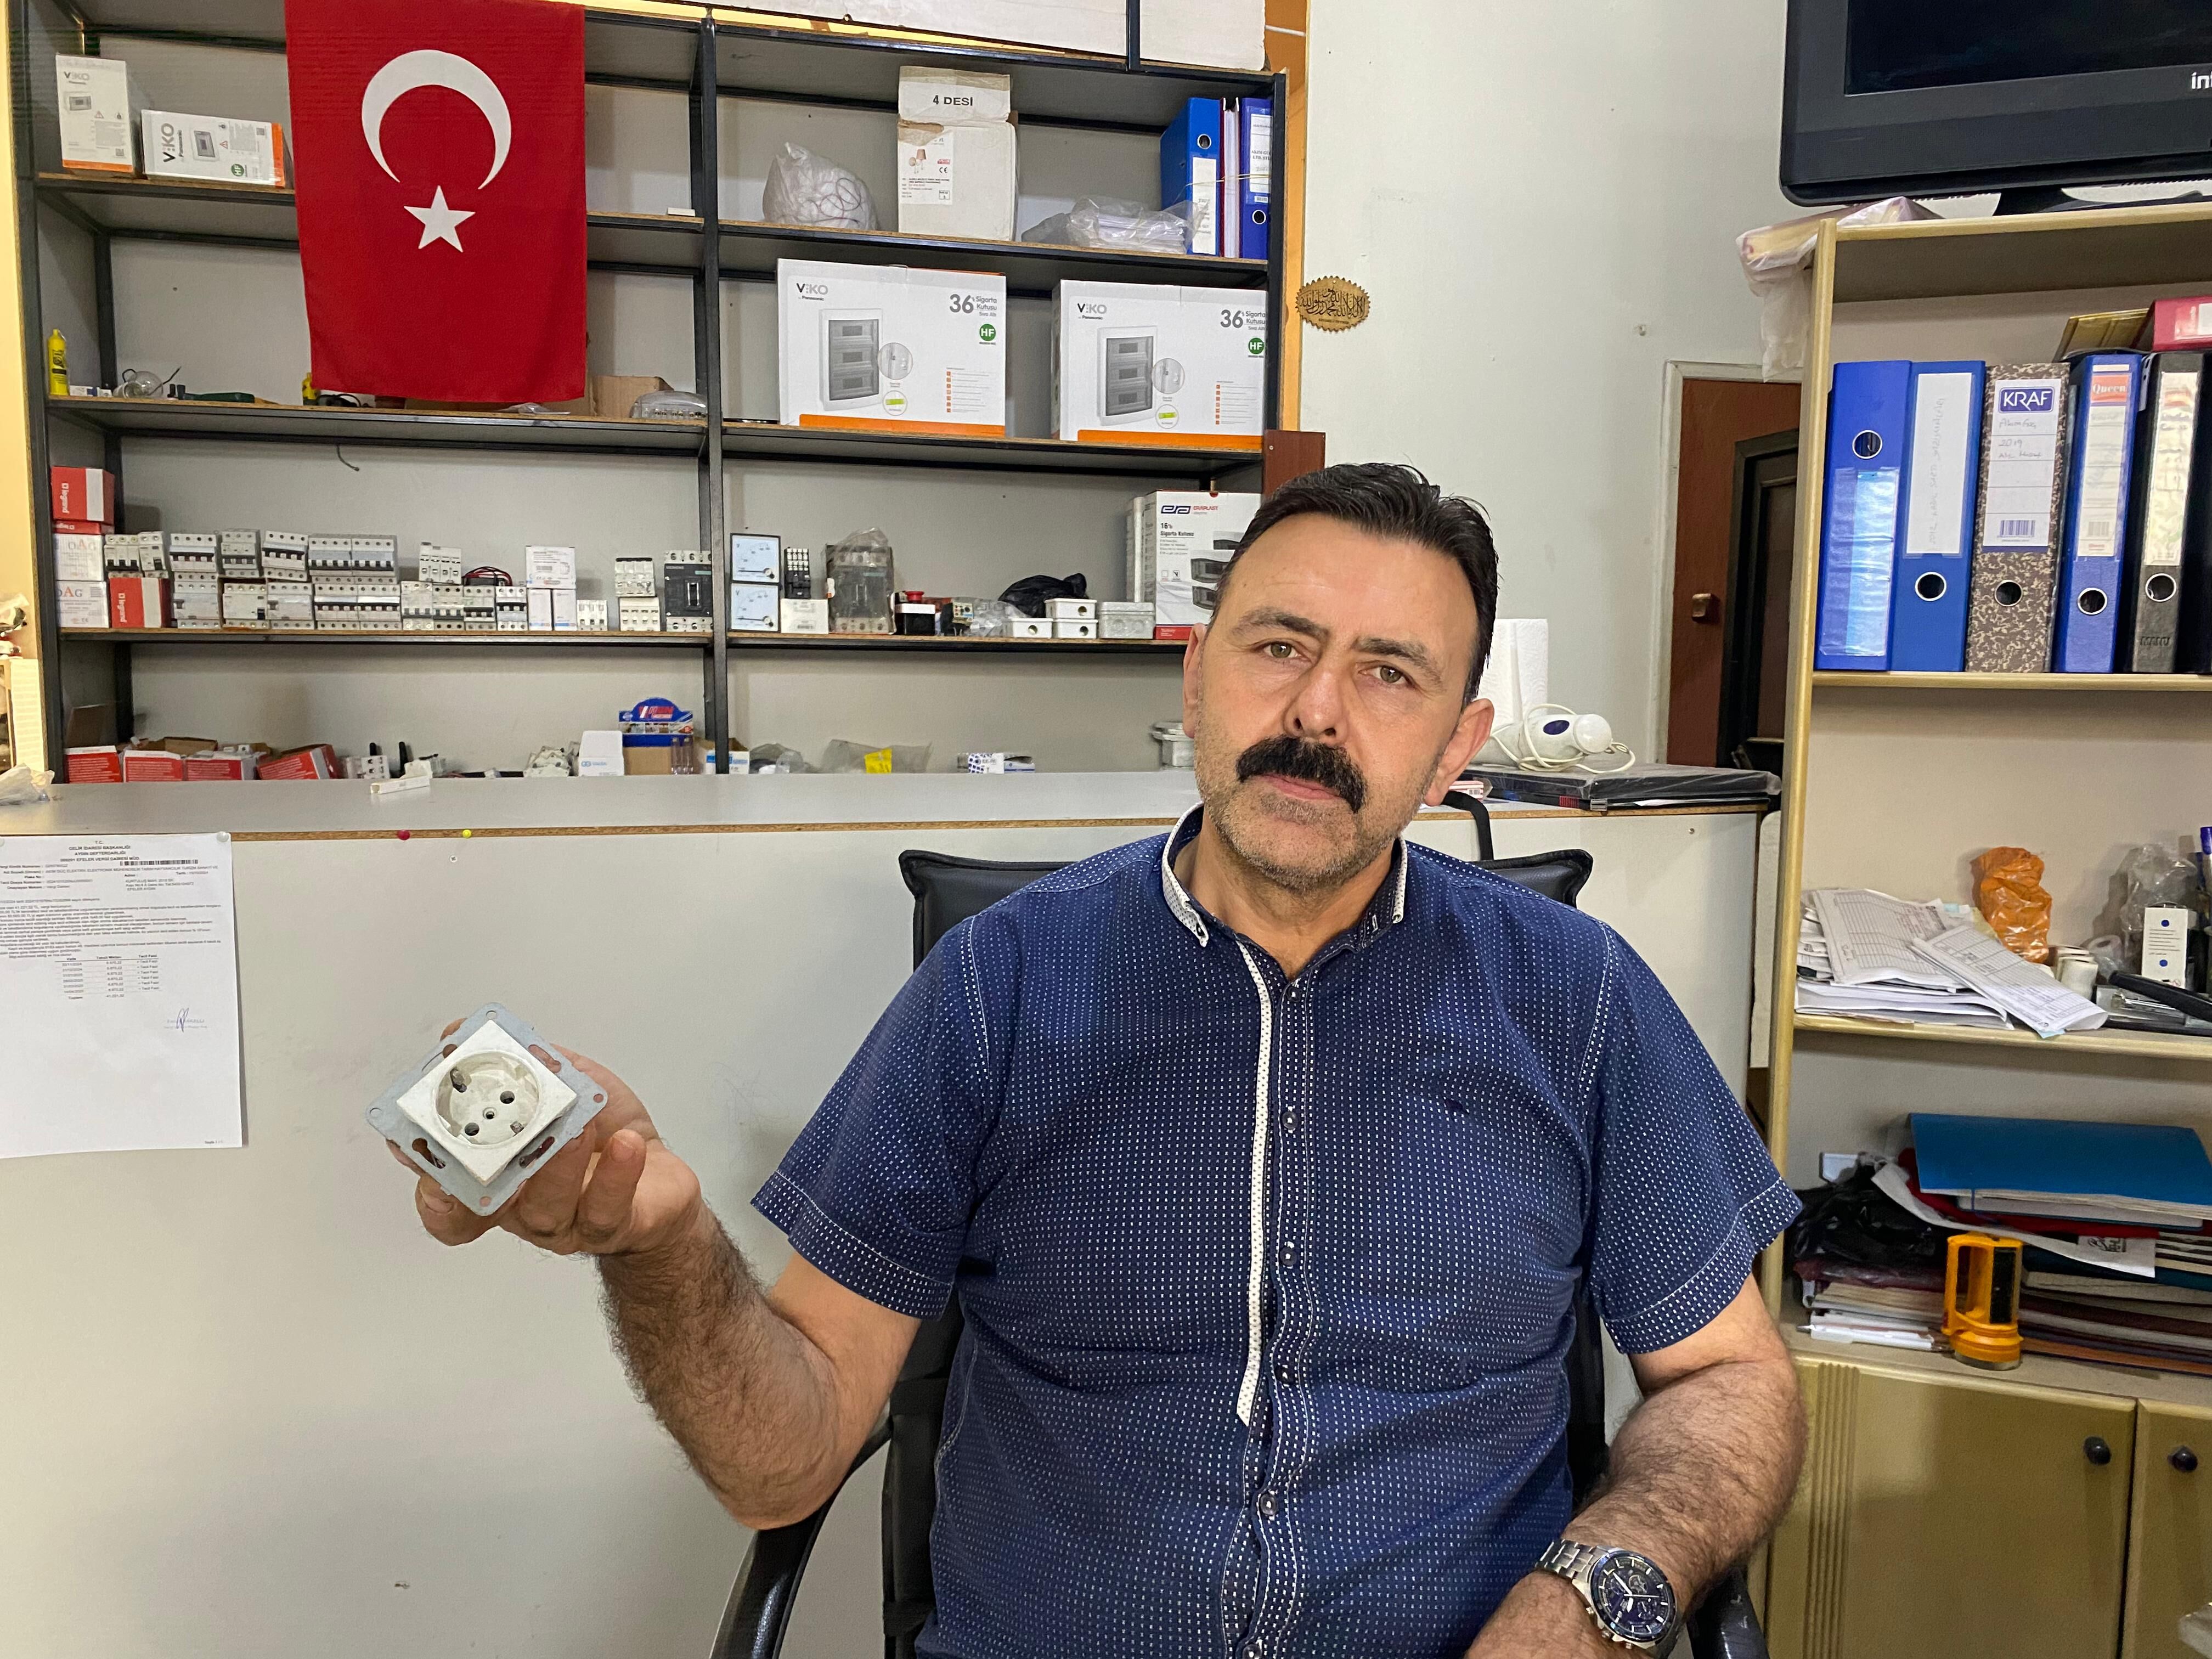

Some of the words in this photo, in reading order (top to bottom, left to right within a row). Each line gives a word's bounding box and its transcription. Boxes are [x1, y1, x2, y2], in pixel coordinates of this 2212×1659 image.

[933, 95, 939, 105] 4
[980, 328, 995, 337] HF
[1249, 342, 1263, 350] HF
[2092, 383, 2126, 393] Queen
[2003, 391, 2052, 411] KRAF
